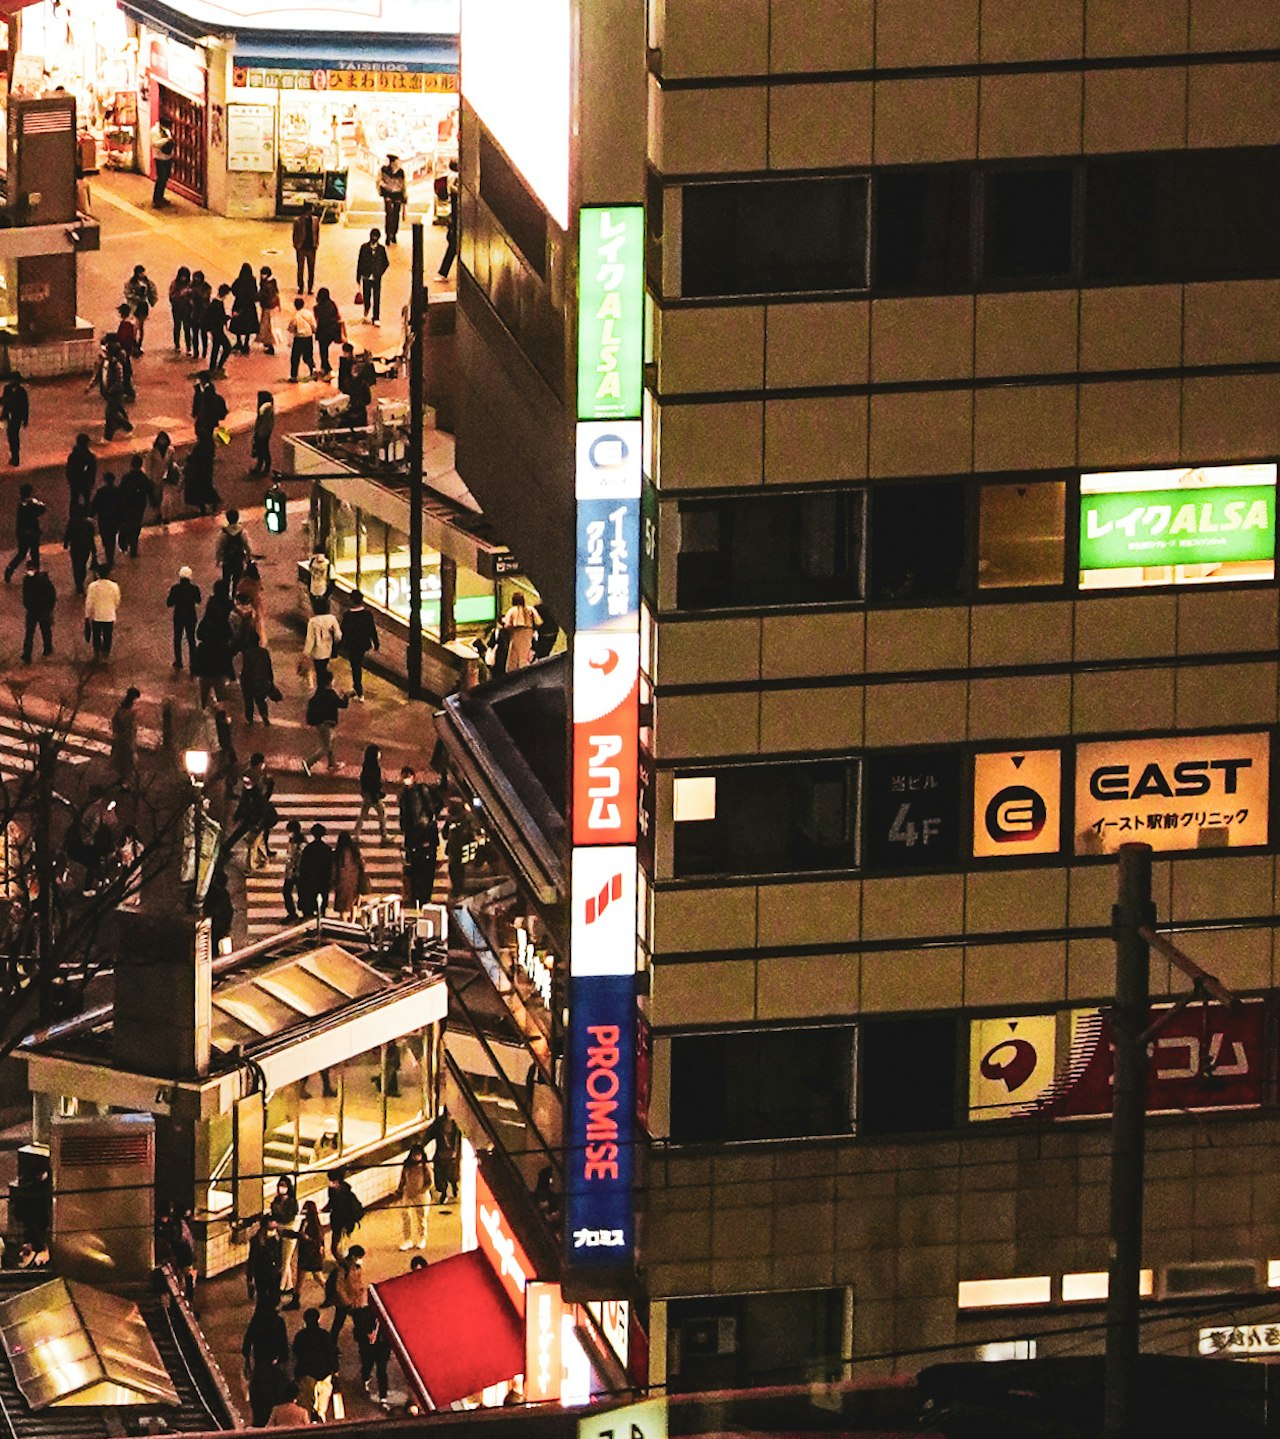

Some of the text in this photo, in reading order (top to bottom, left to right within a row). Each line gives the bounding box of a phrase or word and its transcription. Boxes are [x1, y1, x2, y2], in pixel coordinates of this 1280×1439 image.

[595, 212, 626, 398] レイク ALSA
[587, 733, 624, 830] アコム
[583, 1023, 621, 1182] PROMISE
[1108, 1030, 1250, 1085] コム
[573, 1228, 625, 1249] プロミス
